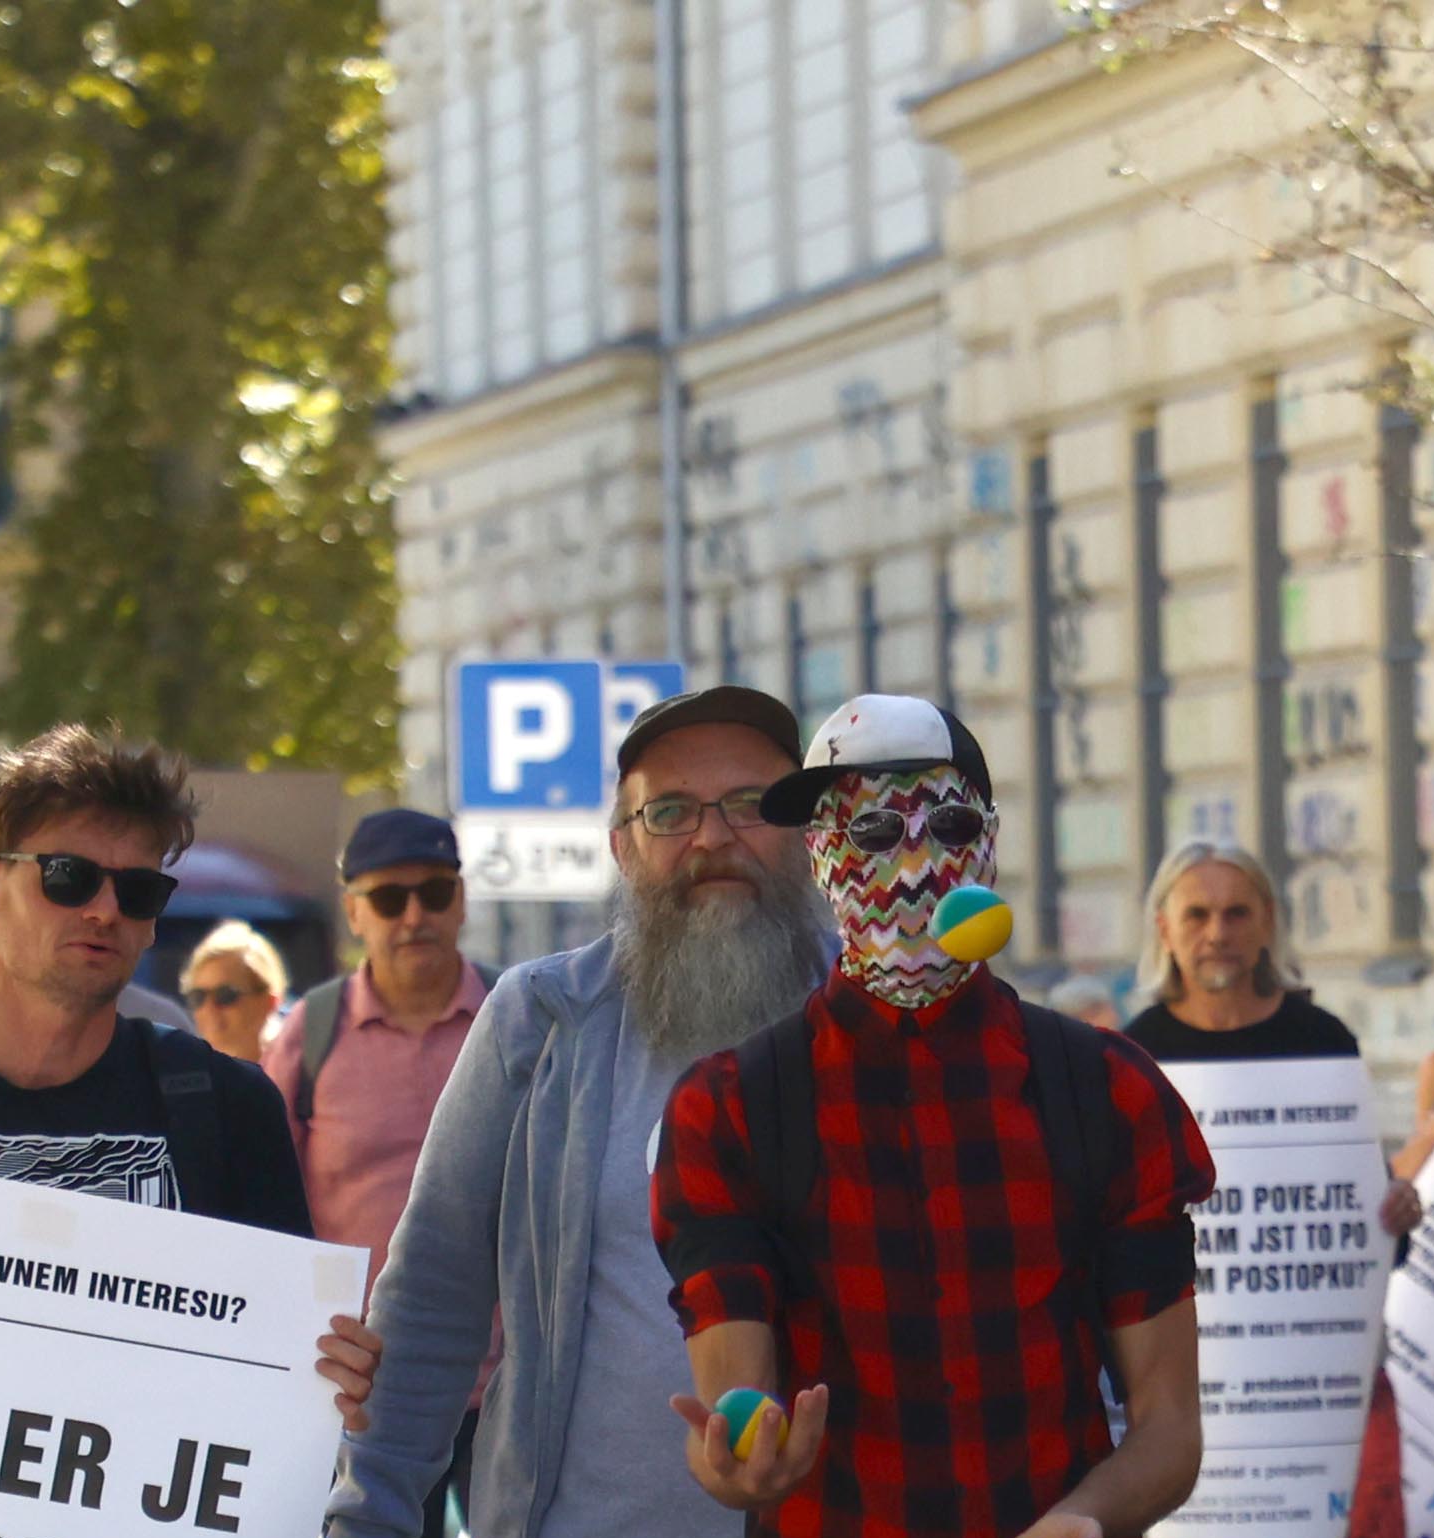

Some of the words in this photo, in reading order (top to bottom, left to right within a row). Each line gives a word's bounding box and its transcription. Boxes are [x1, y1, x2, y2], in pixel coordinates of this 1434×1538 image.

[488, 677, 572, 794] P
[88, 1271, 247, 1324] INTERESU?
[141, 1438, 252, 1534] JE
